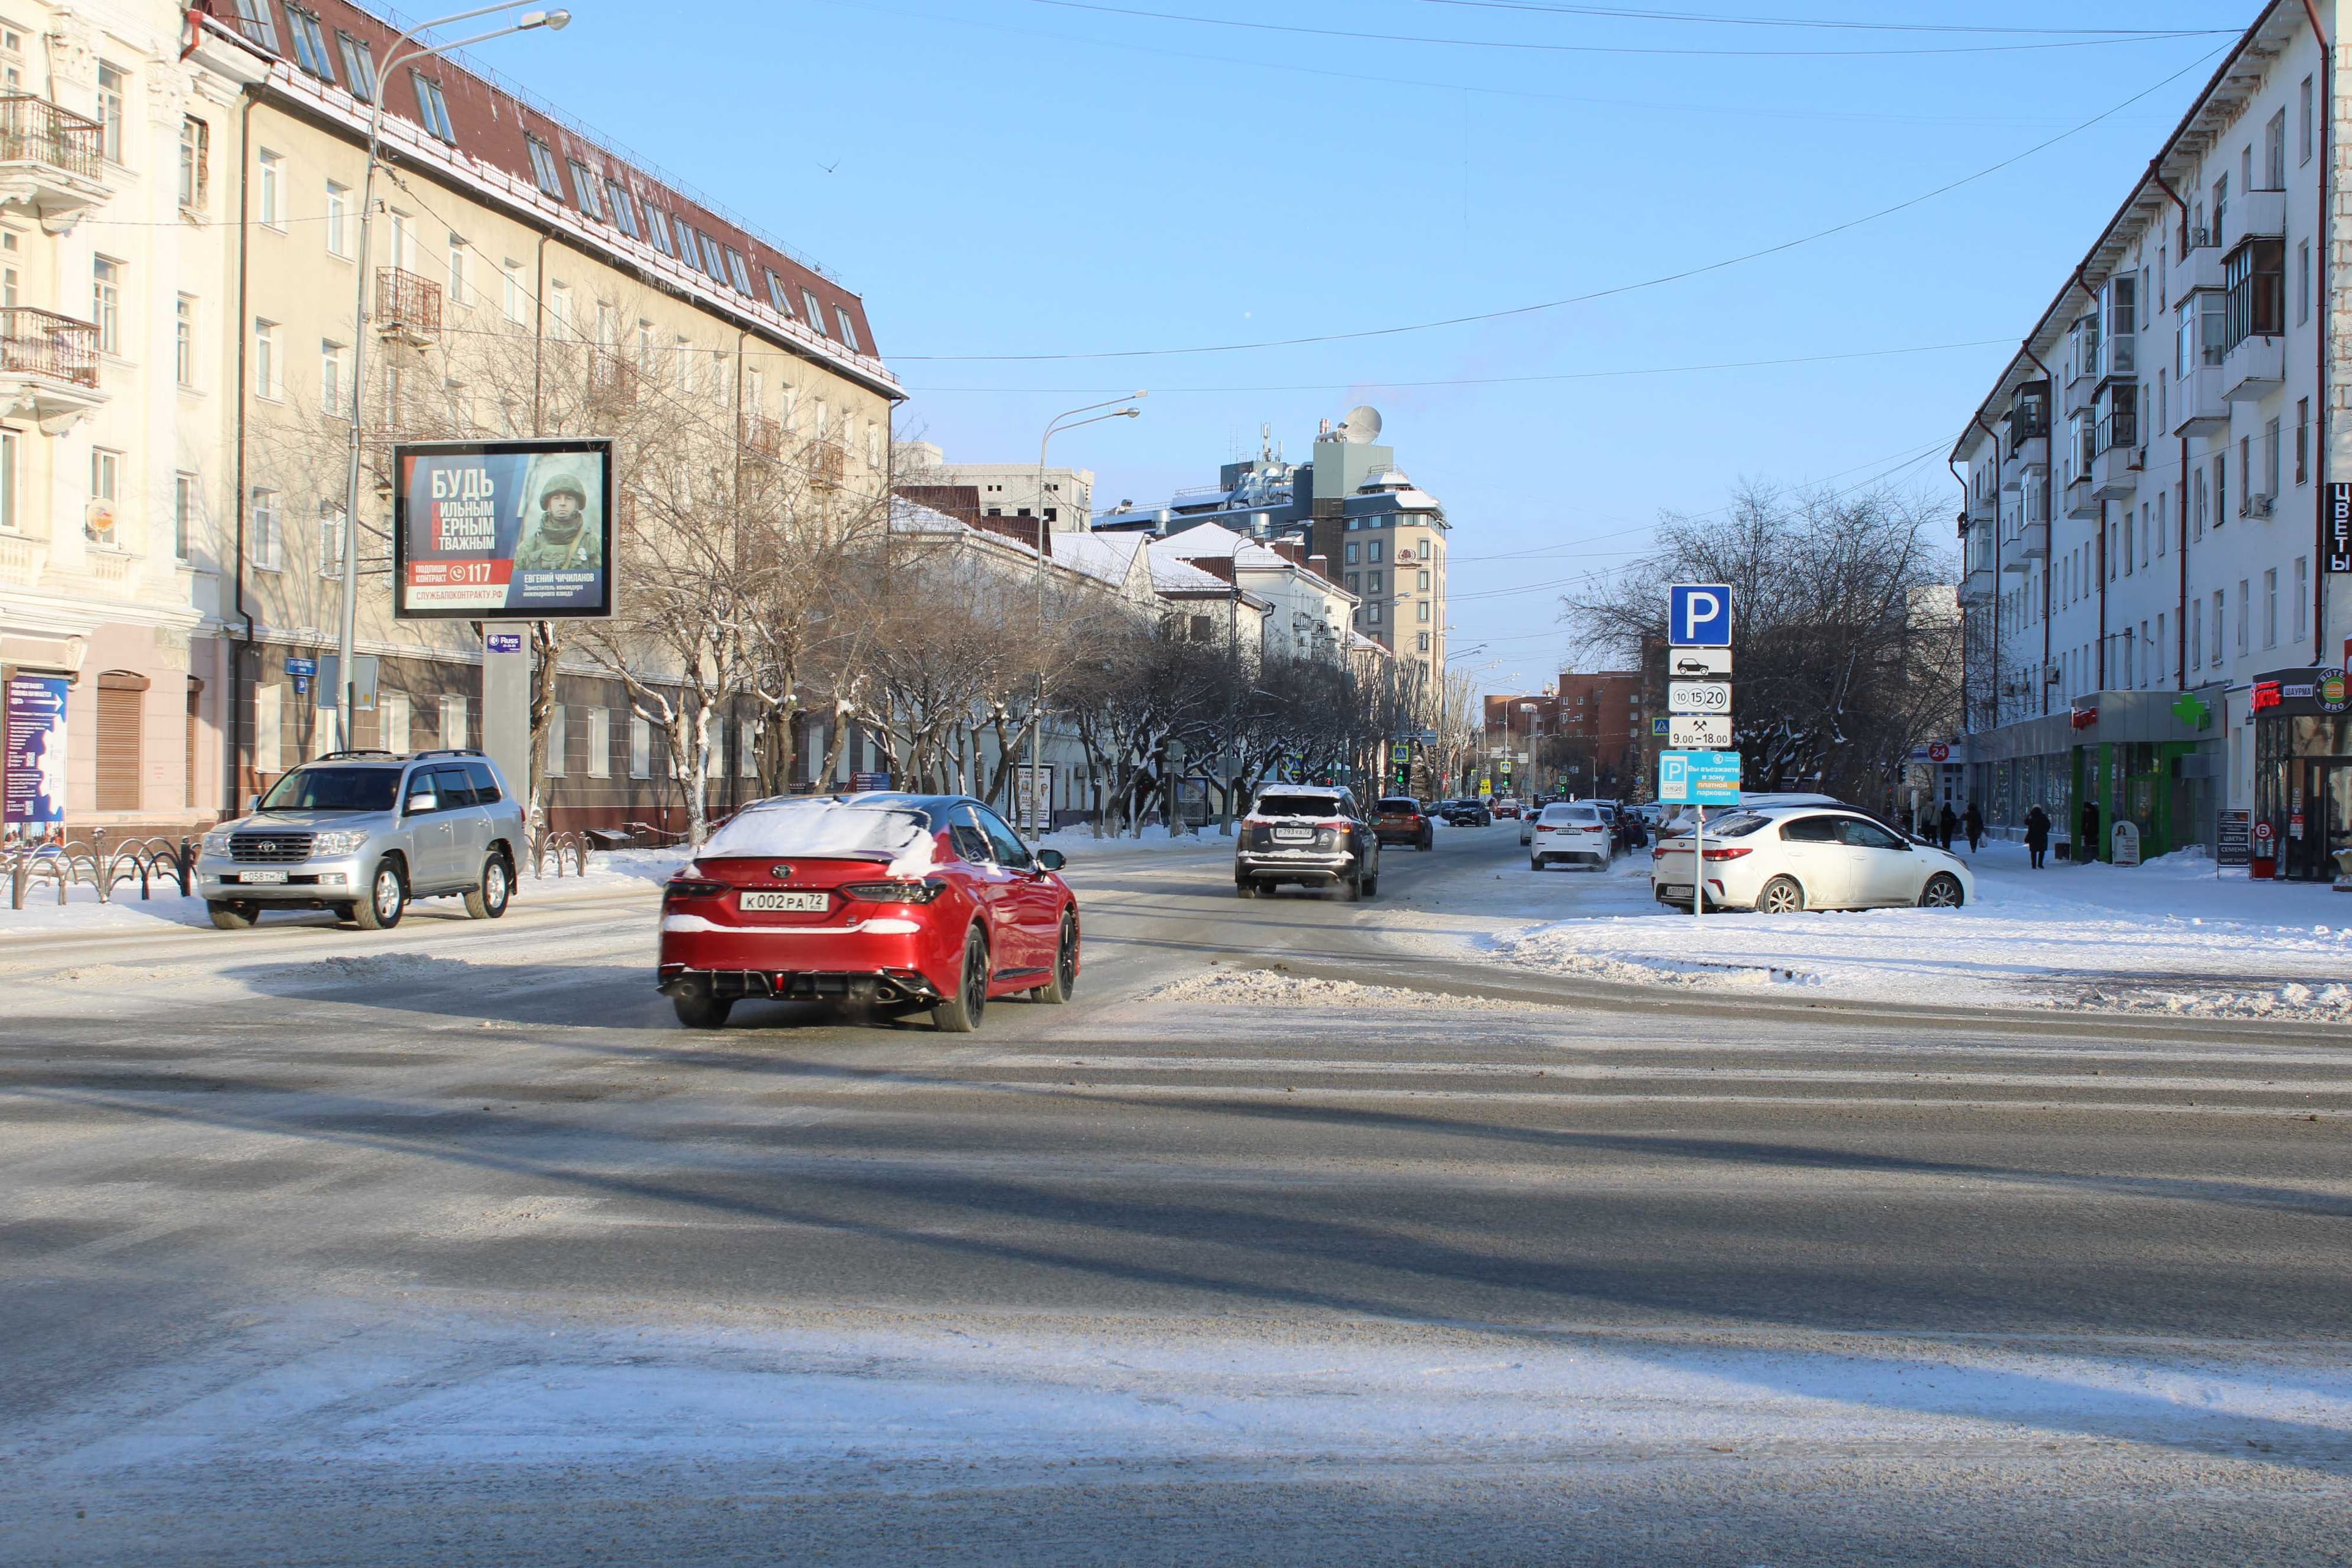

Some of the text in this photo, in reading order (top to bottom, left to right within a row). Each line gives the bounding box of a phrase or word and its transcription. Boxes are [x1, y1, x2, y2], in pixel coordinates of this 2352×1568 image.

[431, 469, 494, 501] БУДЬ
[431, 500, 494, 518] СИЛЬНЫМ
[431, 516, 495, 537] ВЕРНЫМ
[2331, 483, 2351, 571] ЦВЕТЫ
[431, 536, 496, 551] ОТВАЖНЫМ
[415, 565, 447, 573] ПОДПИШИ
[468, 563, 491, 582] 117
[416, 574, 447, 583] КОНТРАКТ
[524, 572, 595, 583] ЕВГЕНИЙ ЧИЧИЛАНОВ
[416, 590, 503, 600] СЛУЖБАПОКОНТРАКТУ.РФ
[1686, 592, 1719, 639] P
[2320, 669, 2346, 682] BUTE
[1691, 692, 1702, 703] 15
[1706, 692, 1724, 704] 20
[2285, 687, 2311, 696] ШАУРМА
[2324, 702, 2344, 710] BRO
[1673, 733, 1694, 744] 9.00
[1703, 733, 1728, 744] 18.00
[1932, 747, 1946, 757] 24
[1669, 763, 1681, 780] P
[746, 894, 823, 909] К002РА 72
